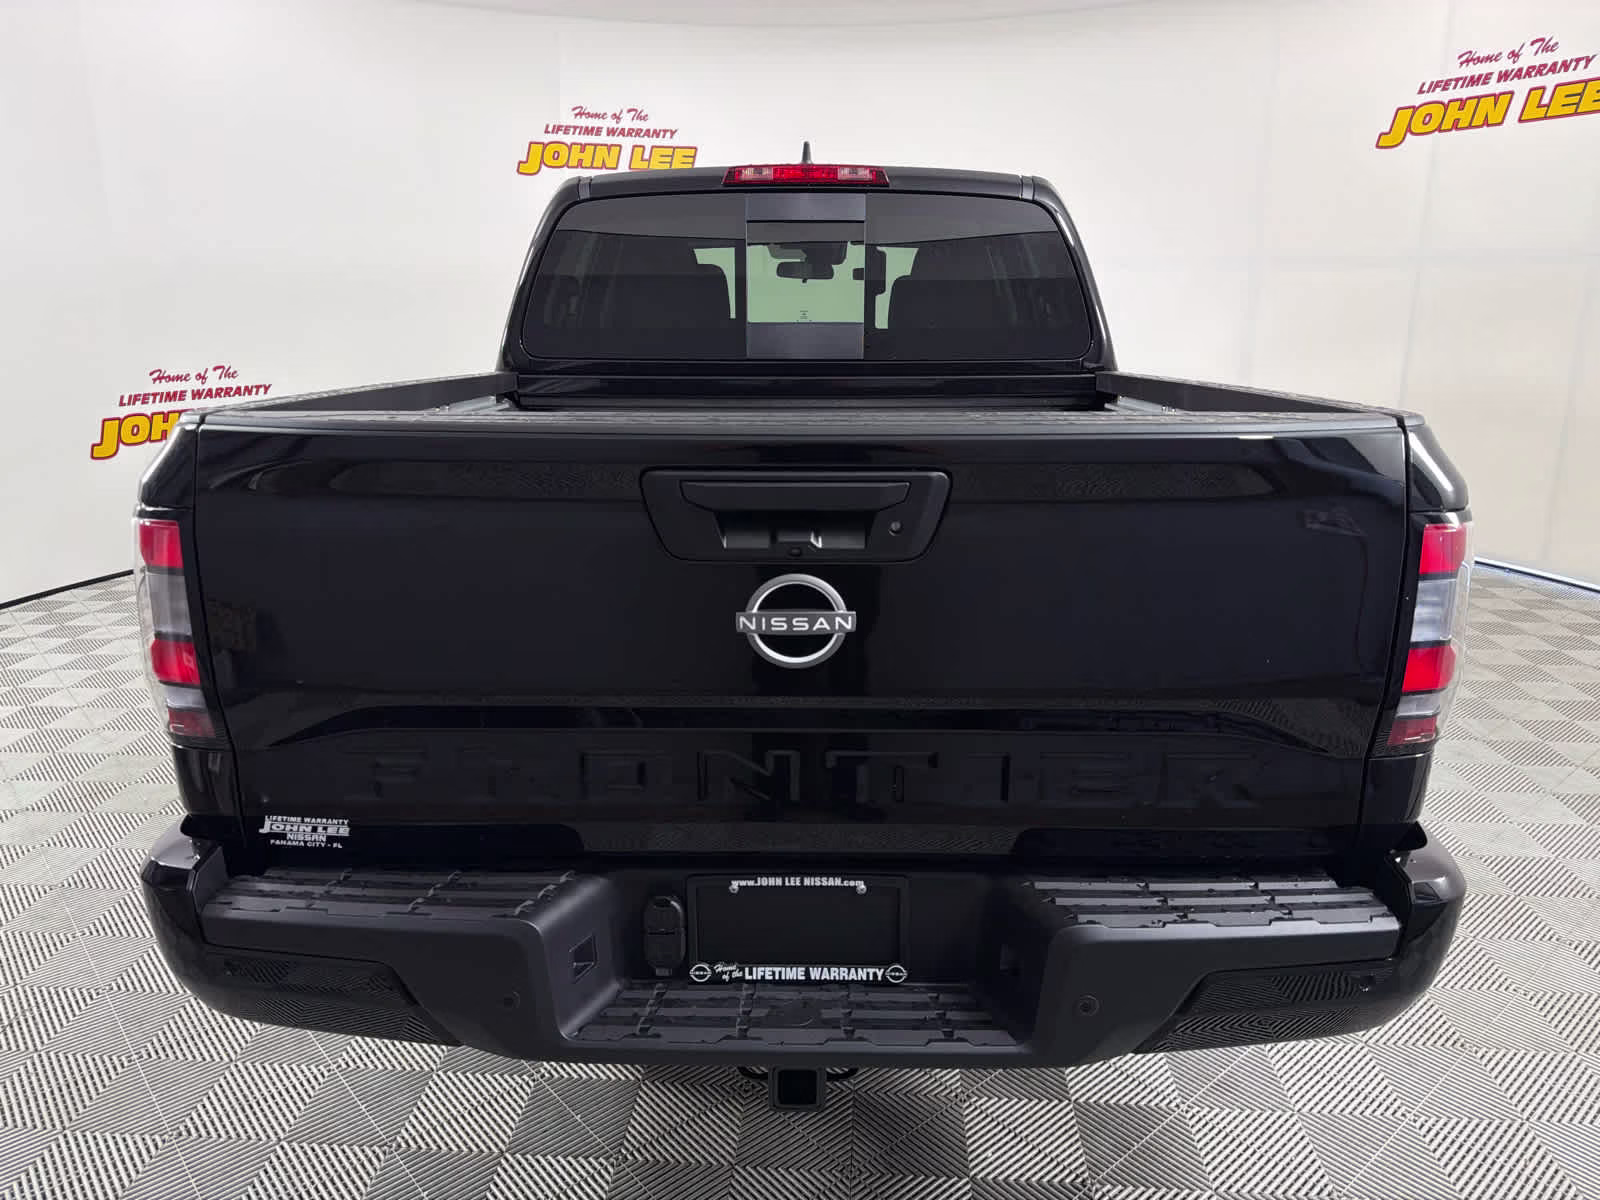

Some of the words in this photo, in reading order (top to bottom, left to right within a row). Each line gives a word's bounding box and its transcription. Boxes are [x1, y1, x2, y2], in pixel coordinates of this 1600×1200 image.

[1457, 50, 1502, 67] Home
[1507, 43, 1525, 62] of
[1530, 36, 1559, 56] The
[1417, 72, 1494, 95] LIFETIME
[1496, 54, 1597, 83] WARRANTY
[571, 106, 607, 120] Home
[610, 109, 623, 124] of
[626, 108, 649, 122] The
[1375, 91, 1515, 149] JOHN
[544, 124, 602, 136] LIFETIME
[606, 127, 677, 139] WARRANTY
[517, 141, 622, 175] JOHN
[628, 145, 697, 170] LEE
[149, 369, 190, 384] Home
[195, 368, 208, 384] of
[212, 365, 238, 380] The
[119, 389, 187, 407] LIFETIME
[191, 384, 272, 401] WARRANTY
[90, 408, 193, 460] JOH
[739, 615, 852, 631] NISSAN
[259, 819, 313, 833] JOHN
[316, 825, 350, 836] LEE
[265, 815, 302, 823] LIFETIME
[303, 817, 349, 825] WARRANTY
[270, 839, 305, 847] PANAMA
[286, 833, 326, 842] NISSAN
[731, 877, 783, 887] www.JOHN
[785, 877, 801, 886] LEE
[803, 877, 864, 887] NISSAN.com
[713, 964, 737, 974] Home
[722, 971, 730, 982] of
[731, 968, 743, 978] the
[744, 967, 806, 980] LIFETIME
[809, 967, 884, 981] WARRANTY
